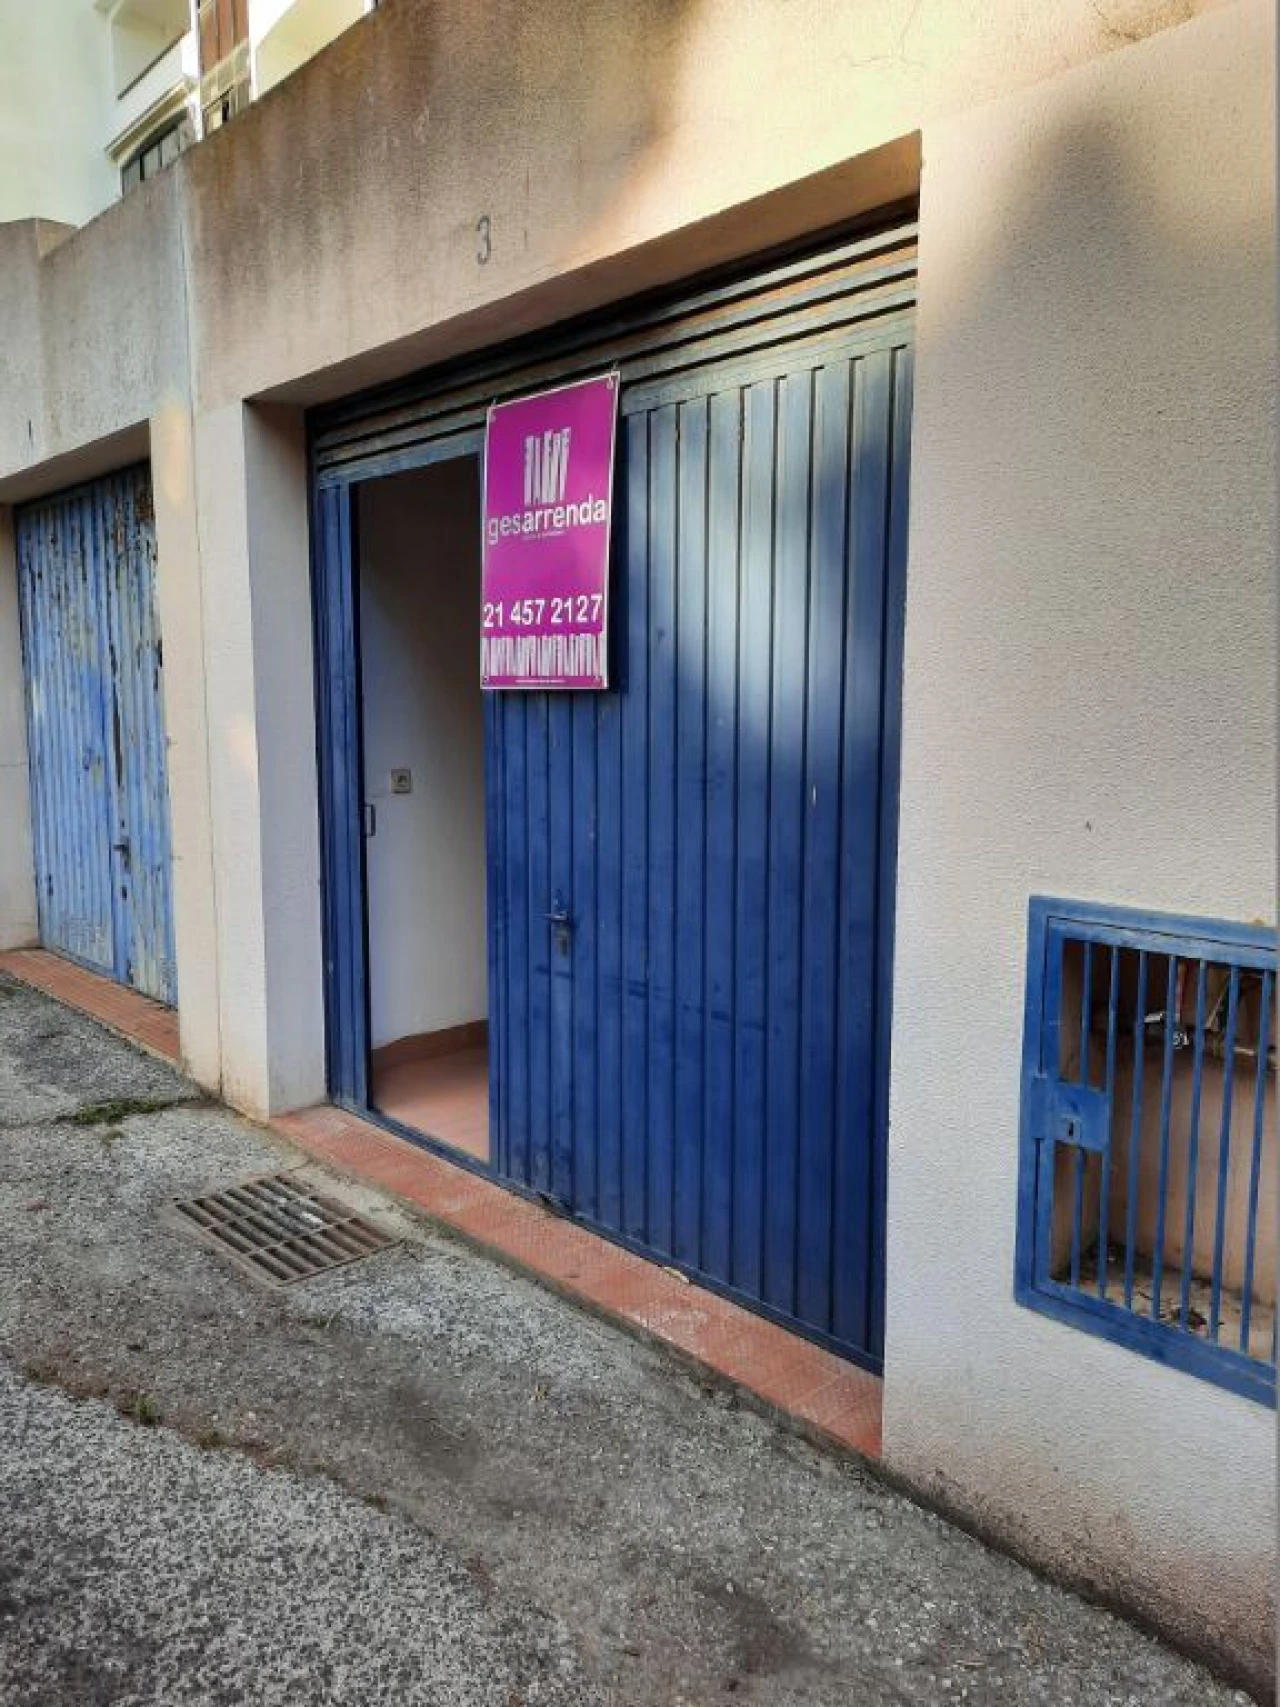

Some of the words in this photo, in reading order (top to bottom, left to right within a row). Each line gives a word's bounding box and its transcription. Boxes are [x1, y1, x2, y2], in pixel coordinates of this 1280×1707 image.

[476, 214, 492, 265] 3
[488, 493, 605, 545] gesarrenda
[483, 602, 503, 628] 21
[510, 598, 545, 625] 457
[550, 593, 603, 623] 2127
